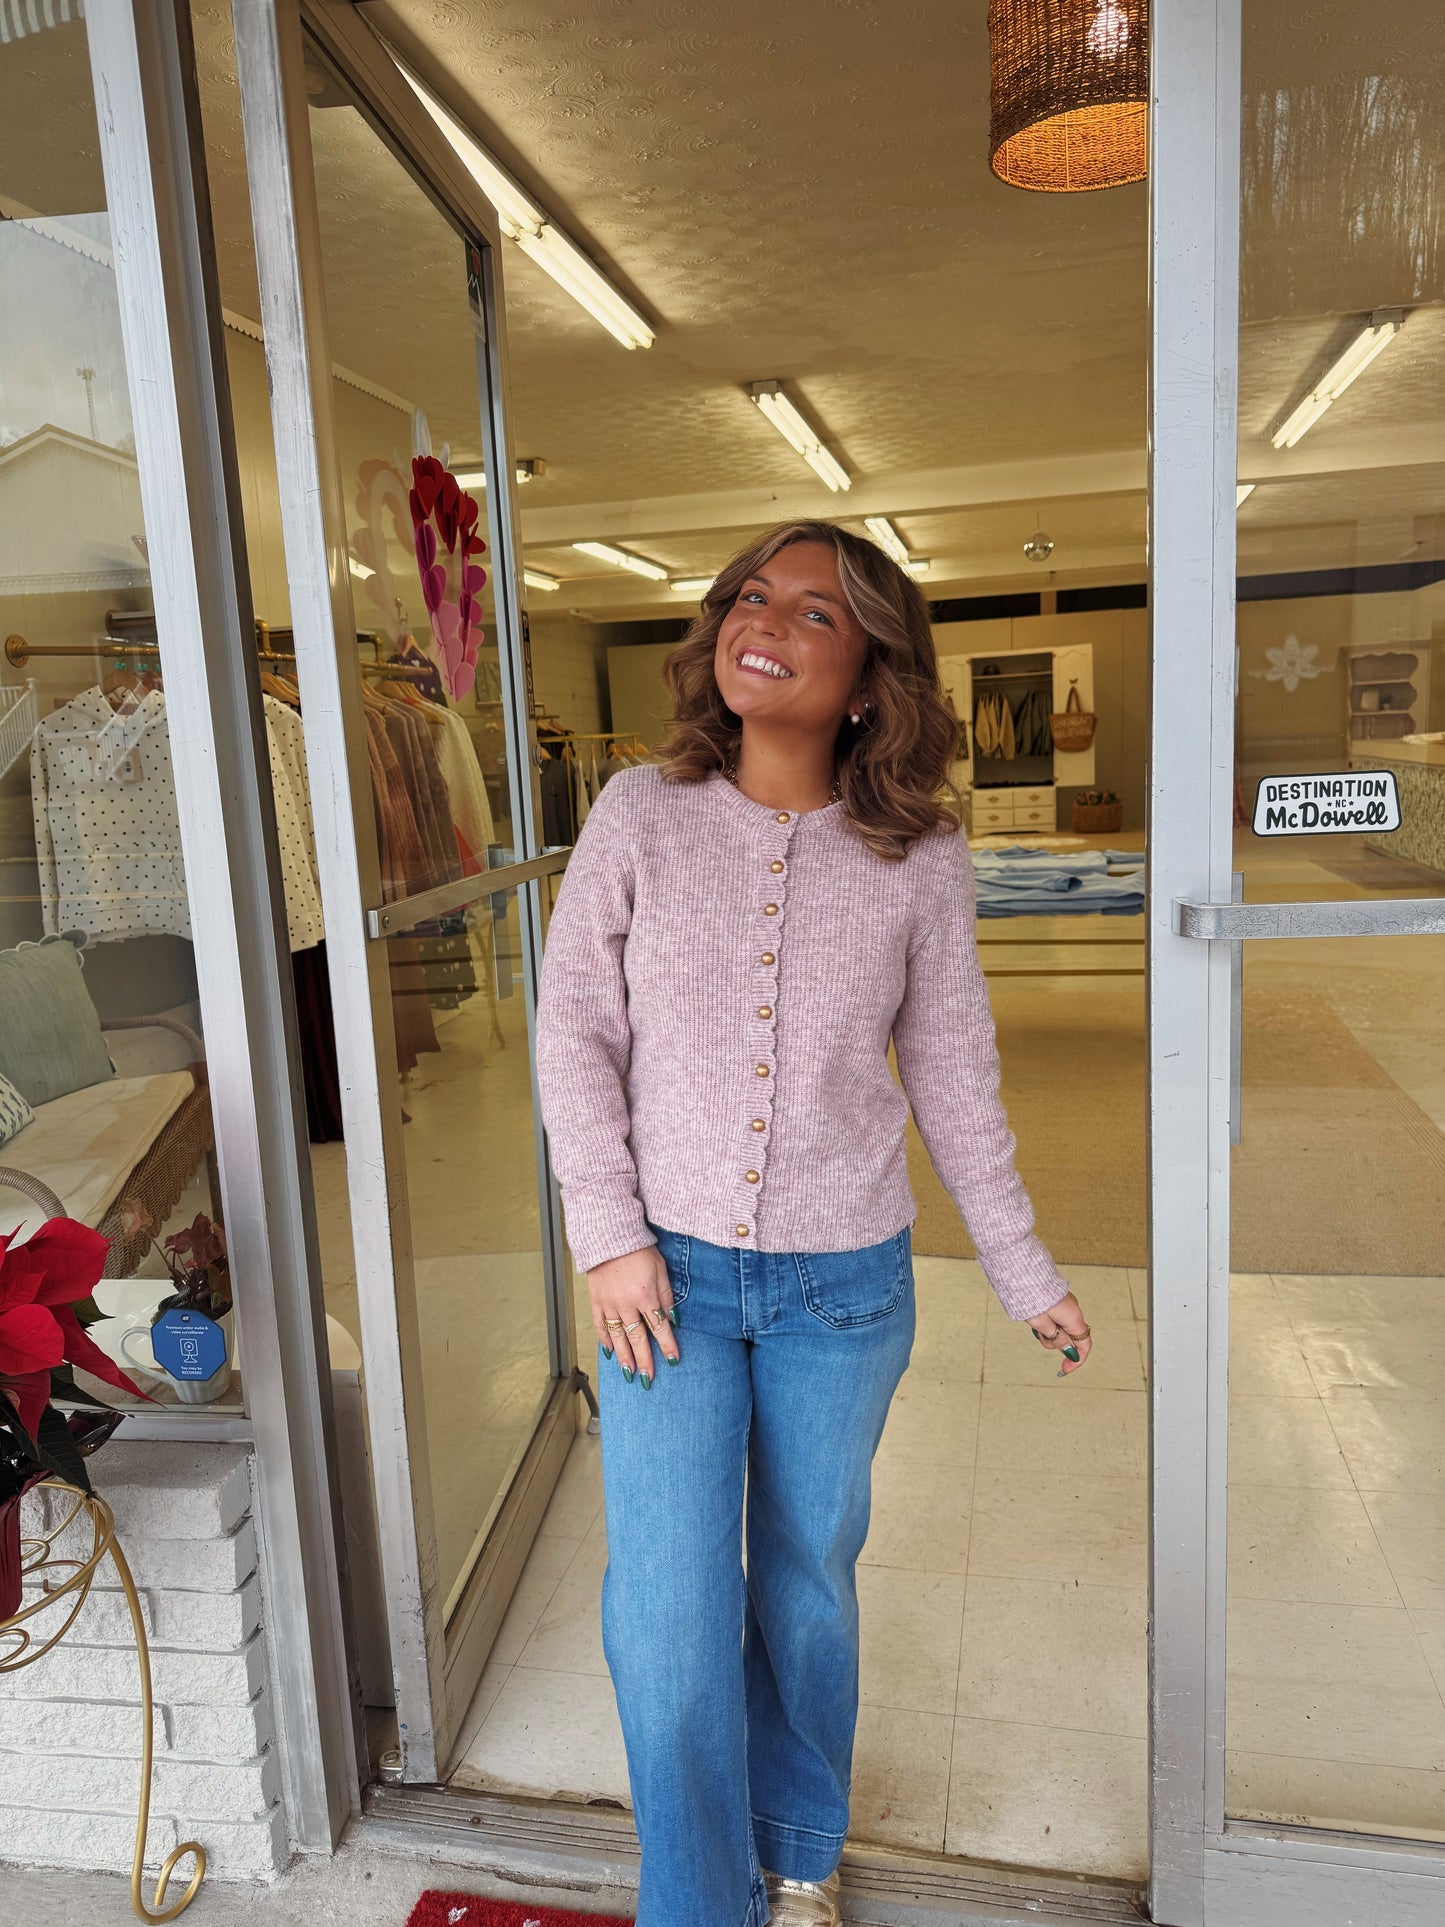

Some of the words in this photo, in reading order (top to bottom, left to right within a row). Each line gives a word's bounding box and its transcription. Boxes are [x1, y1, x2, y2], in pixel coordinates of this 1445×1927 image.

[1266, 780, 1387, 802] DESTINATION
[1335, 799, 1347, 808] NC
[1266, 801, 1388, 830] McDowell
